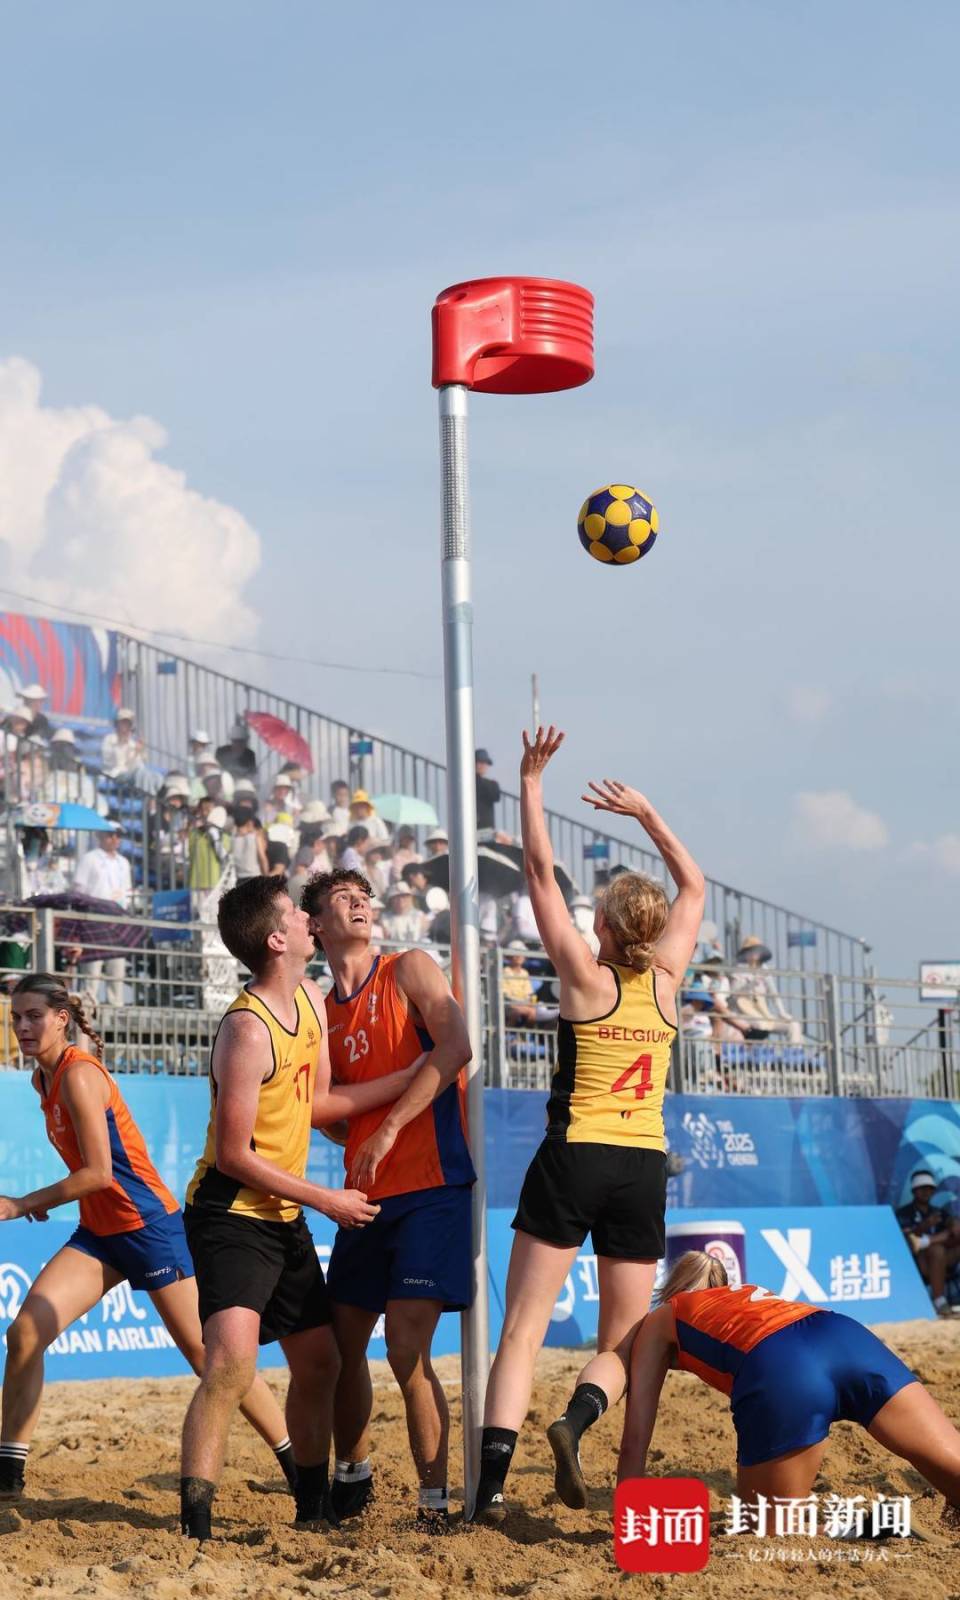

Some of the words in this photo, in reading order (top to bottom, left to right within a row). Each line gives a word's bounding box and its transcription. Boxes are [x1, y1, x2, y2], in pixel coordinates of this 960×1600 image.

[343, 1029, 369, 1063] 23
[598, 1027, 669, 1043] BELGIUM
[293, 1063, 310, 1103] 17
[611, 1053, 653, 1100] 4
[403, 1278, 429, 1286] CRAFT
[830, 1252, 891, 1301] 特步
[106, 1326, 178, 1350] AIRLIN
